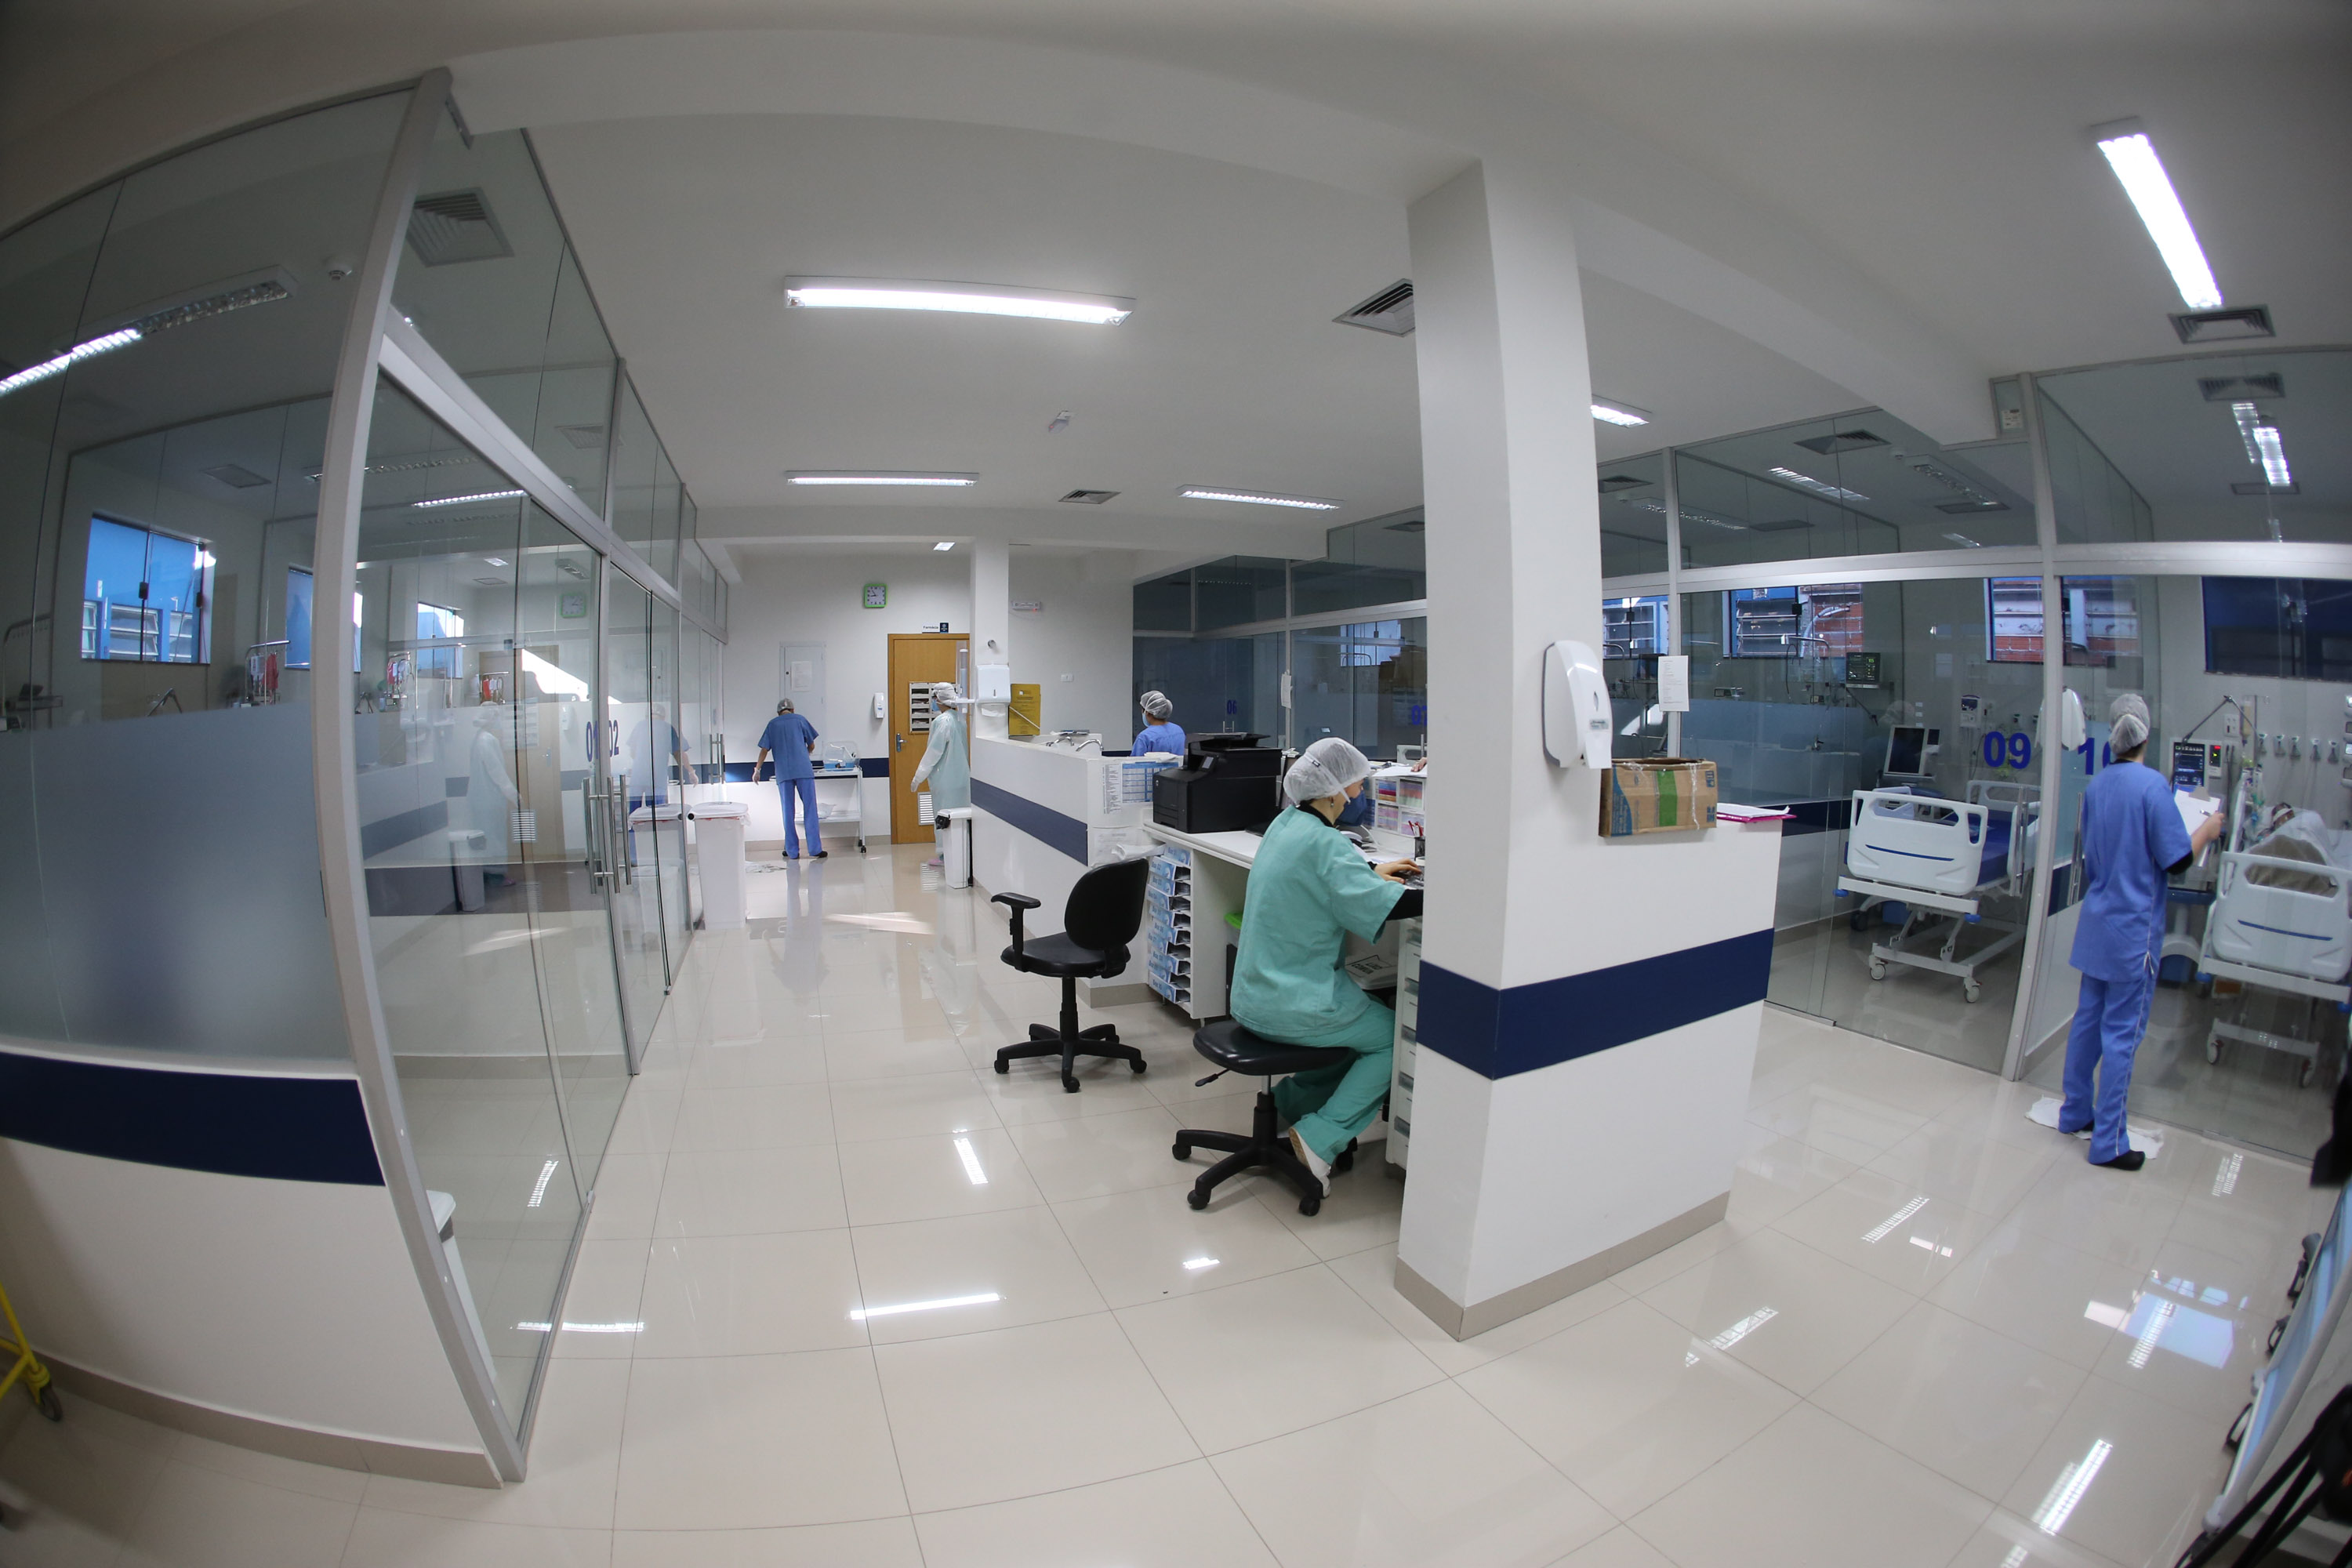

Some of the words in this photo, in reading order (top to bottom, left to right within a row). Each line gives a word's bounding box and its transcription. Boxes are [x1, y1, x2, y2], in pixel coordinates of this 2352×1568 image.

[1226, 699, 1237, 715] 06
[586, 720, 600, 762] 01
[1984, 731, 2031, 770] 09
[2078, 737, 2111, 775] 1
